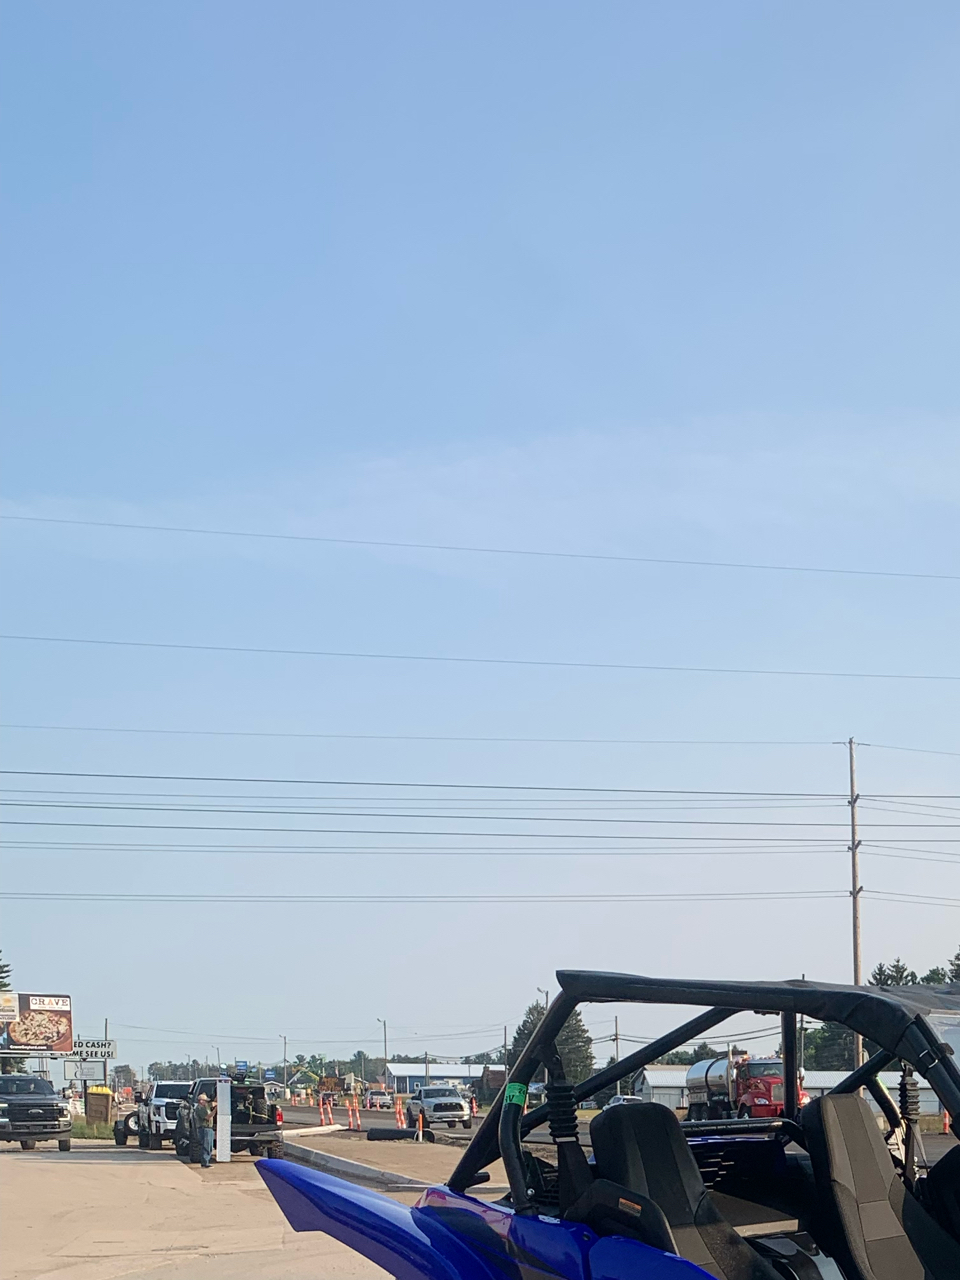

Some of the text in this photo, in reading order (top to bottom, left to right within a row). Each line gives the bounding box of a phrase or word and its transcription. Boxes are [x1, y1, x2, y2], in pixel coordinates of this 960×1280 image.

[31, 998, 68, 1006] CRAVE
[85, 1041, 112, 1049] CASH?
[85, 1050, 98, 1058] SEE
